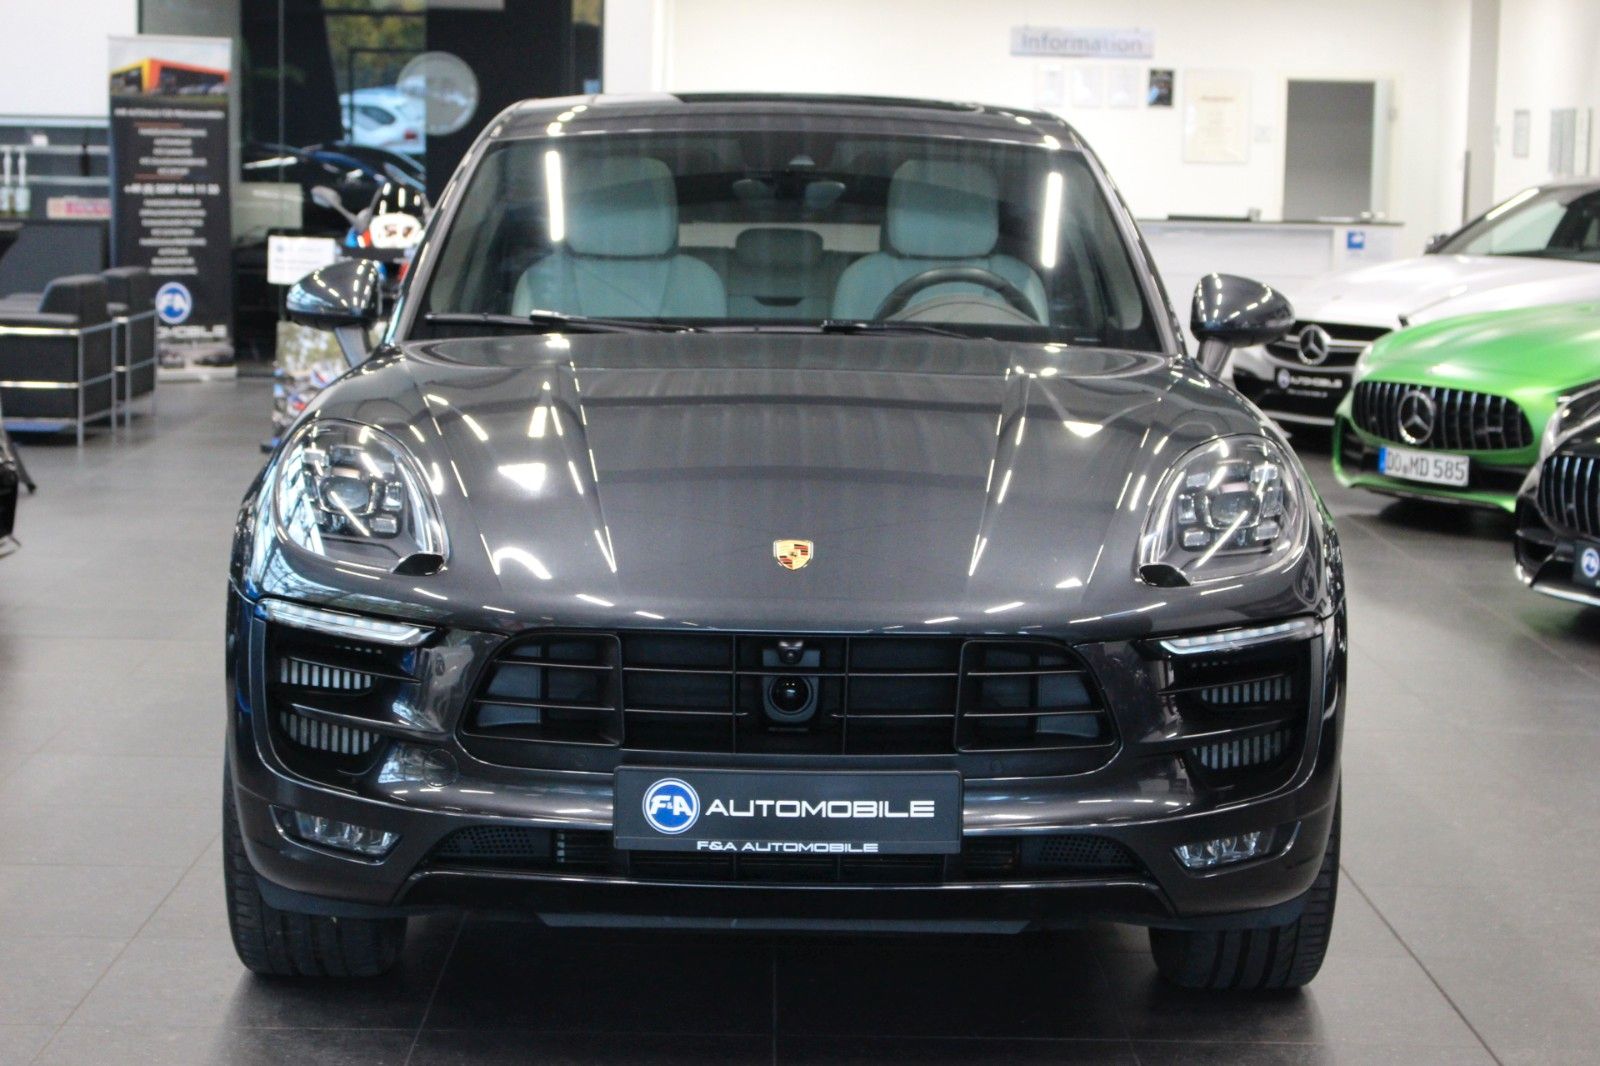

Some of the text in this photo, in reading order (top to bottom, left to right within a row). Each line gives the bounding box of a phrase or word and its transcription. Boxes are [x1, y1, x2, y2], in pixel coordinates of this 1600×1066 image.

[1433, 459, 1466, 481] 585
[705, 799, 935, 818] AUTOMOBILE
[696, 840, 879, 853] F&A AUTOMOBILE
